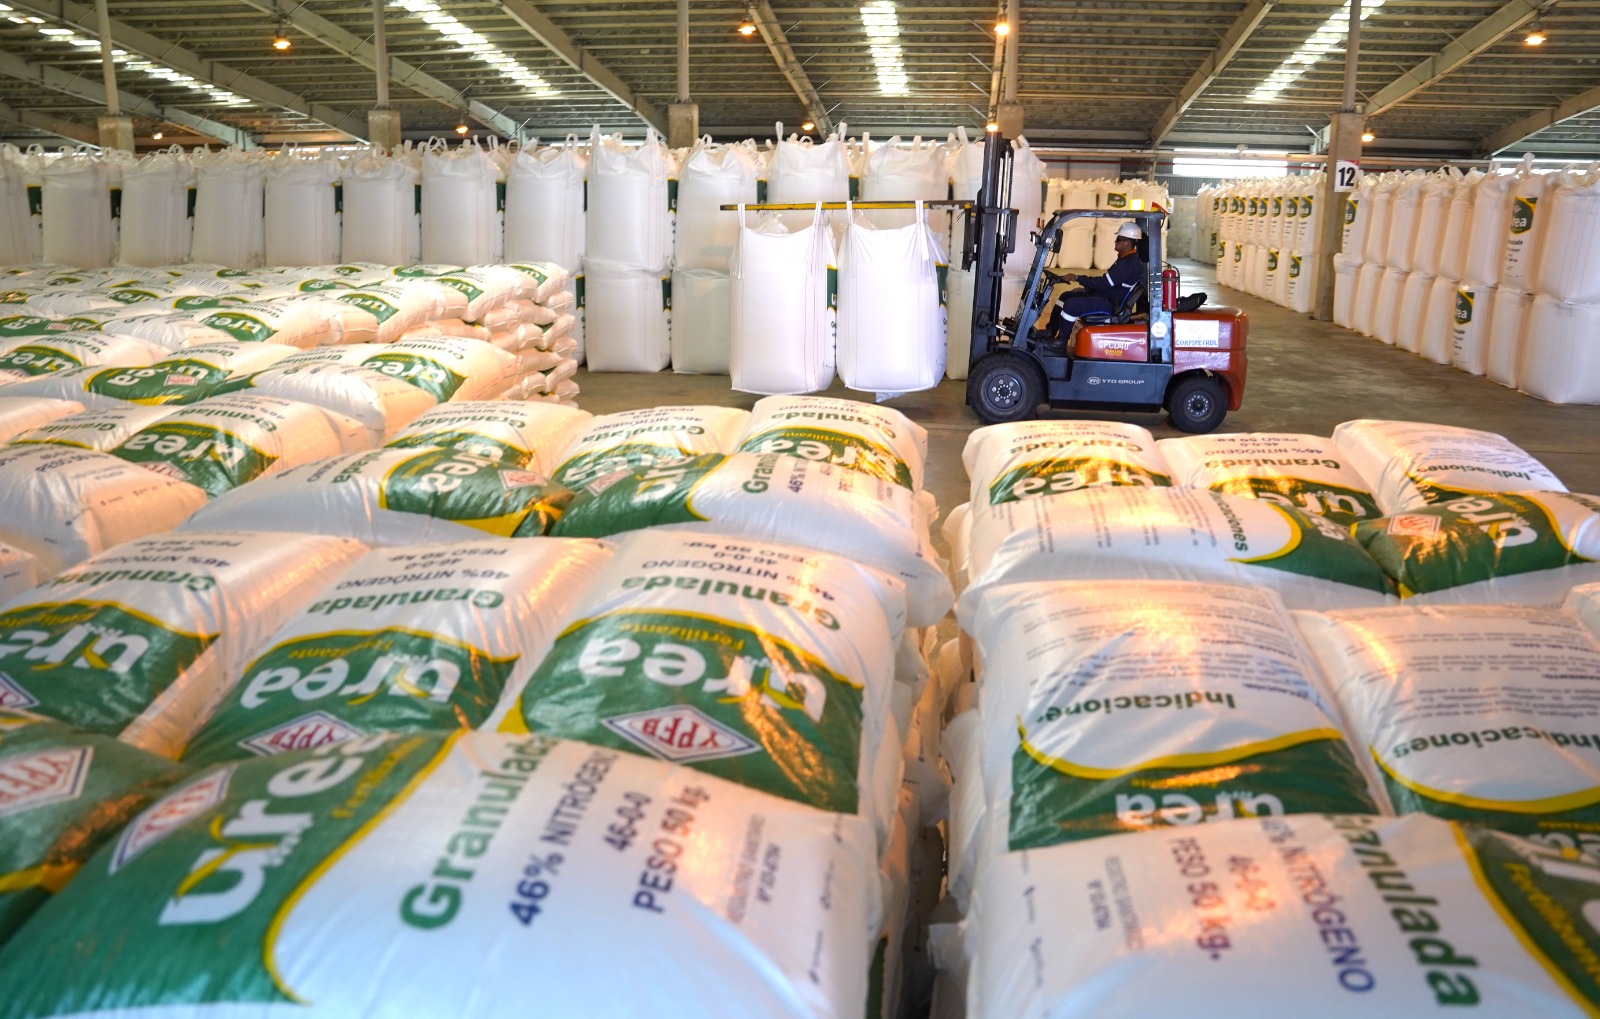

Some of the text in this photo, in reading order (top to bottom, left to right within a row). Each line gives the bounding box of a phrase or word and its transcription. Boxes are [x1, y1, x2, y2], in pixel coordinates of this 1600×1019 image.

[1338, 167, 1355, 187] 12
[365, 361, 446, 384] urea
[582, 425, 705, 443] Granulada
[771, 411, 896, 439] Granulada
[779, 432, 850, 445] Fertilizante
[124, 434, 245, 469] urea
[1010, 440, 1143, 453] Granulada
[1204, 458, 1341, 470] Granulada
[1447, 497, 1538, 549] ure
[714, 551, 778, 566] 46-0-0
[723, 543, 752, 553] 50
[335, 568, 511, 591] 46% NITRÓGENO
[641, 558, 779, 581] NITRÓGENO
[307, 588, 504, 616] Granulada
[621, 575, 841, 632] Granulada
[0, 623, 150, 673] ure
[618, 622, 745, 651] Fertilizante
[240, 652, 461, 709] urea
[578, 636, 827, 723] urea
[1036, 690, 1236, 724] Indicacione
[267, 723, 335, 751] YPFB
[641, 717, 720, 750] YPFB
[1393, 726, 1600, 758] Indicaciones
[605, 791, 652, 851] 46-0-0
[633, 837, 684, 914] PESO
[662, 806, 694, 845] 50
[1170, 836, 1211, 877] PESO
[508, 852, 566, 926] 46%
[1187, 881, 1224, 909] 50
[1279, 846, 1375, 993] NITRÓGENO
